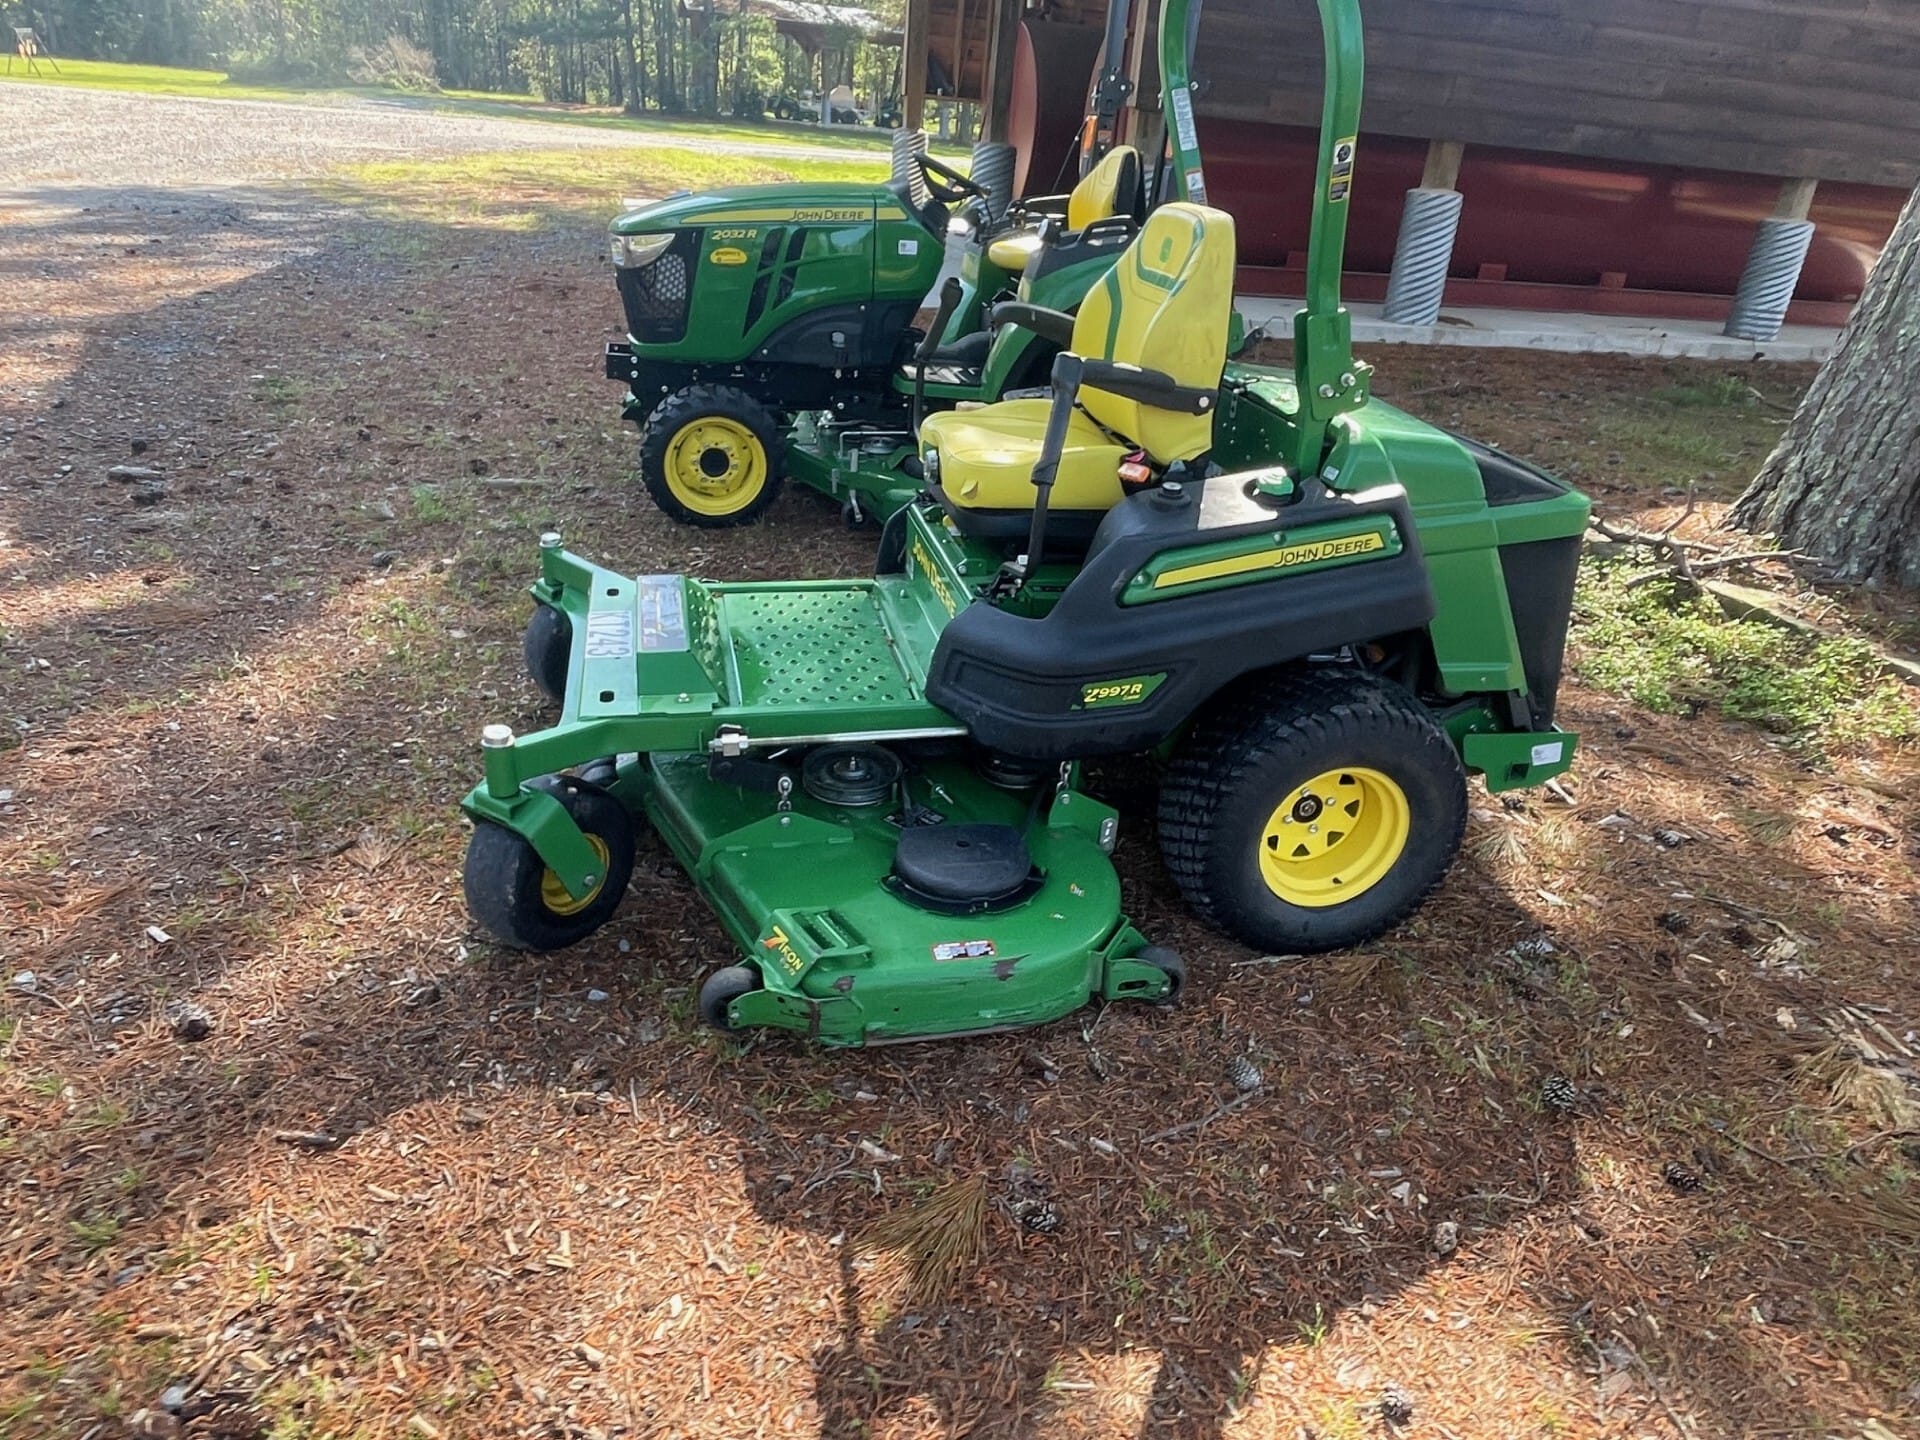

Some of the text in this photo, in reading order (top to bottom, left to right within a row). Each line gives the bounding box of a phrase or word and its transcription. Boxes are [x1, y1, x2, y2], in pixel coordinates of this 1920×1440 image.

[791, 209, 865, 221] JOHN DEERE
[1275, 538, 1375, 567] JOHN DEERE
[587, 611, 631, 657] KT243
